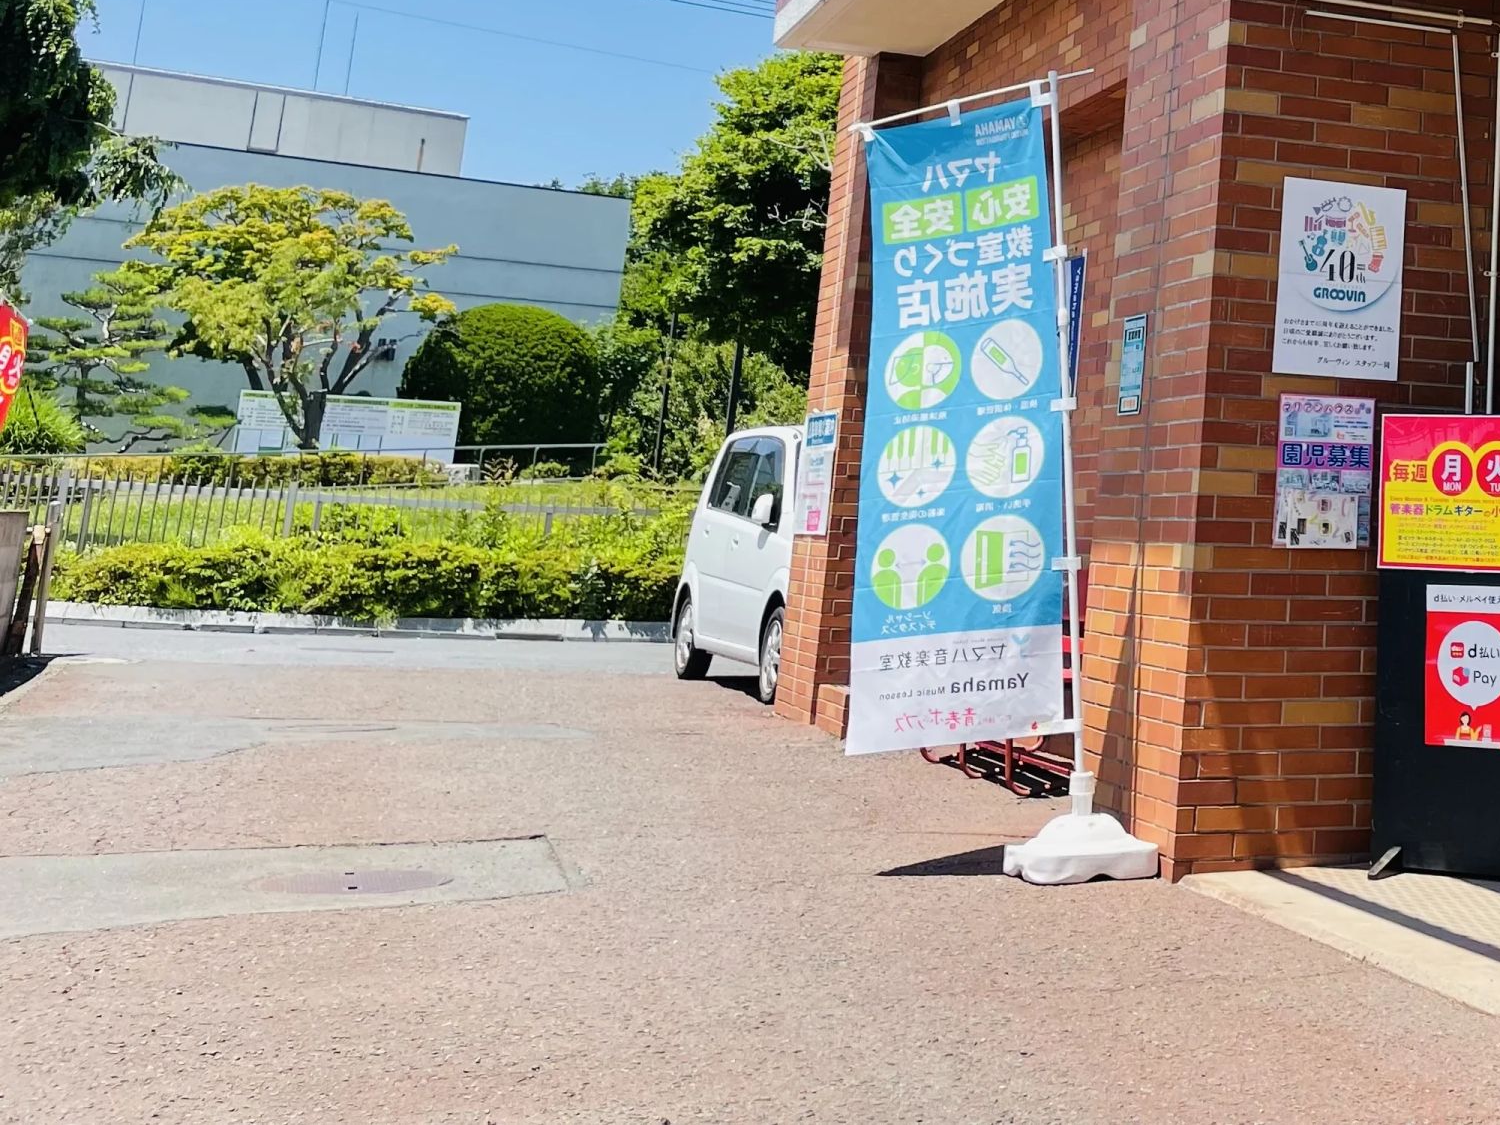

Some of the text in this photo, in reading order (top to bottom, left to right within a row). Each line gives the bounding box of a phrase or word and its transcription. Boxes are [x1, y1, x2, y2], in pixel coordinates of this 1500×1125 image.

[1314, 287, 1366, 303] GROOVIN
[1282, 443, 1370, 467] 園児募集
[1393, 463, 1427, 483] 毎週
[1441, 454, 1461, 482] 月
[1443, 482, 1461, 492] MON
[1468, 643, 1500, 659] d払い
[1473, 670, 1497, 687] Pay
